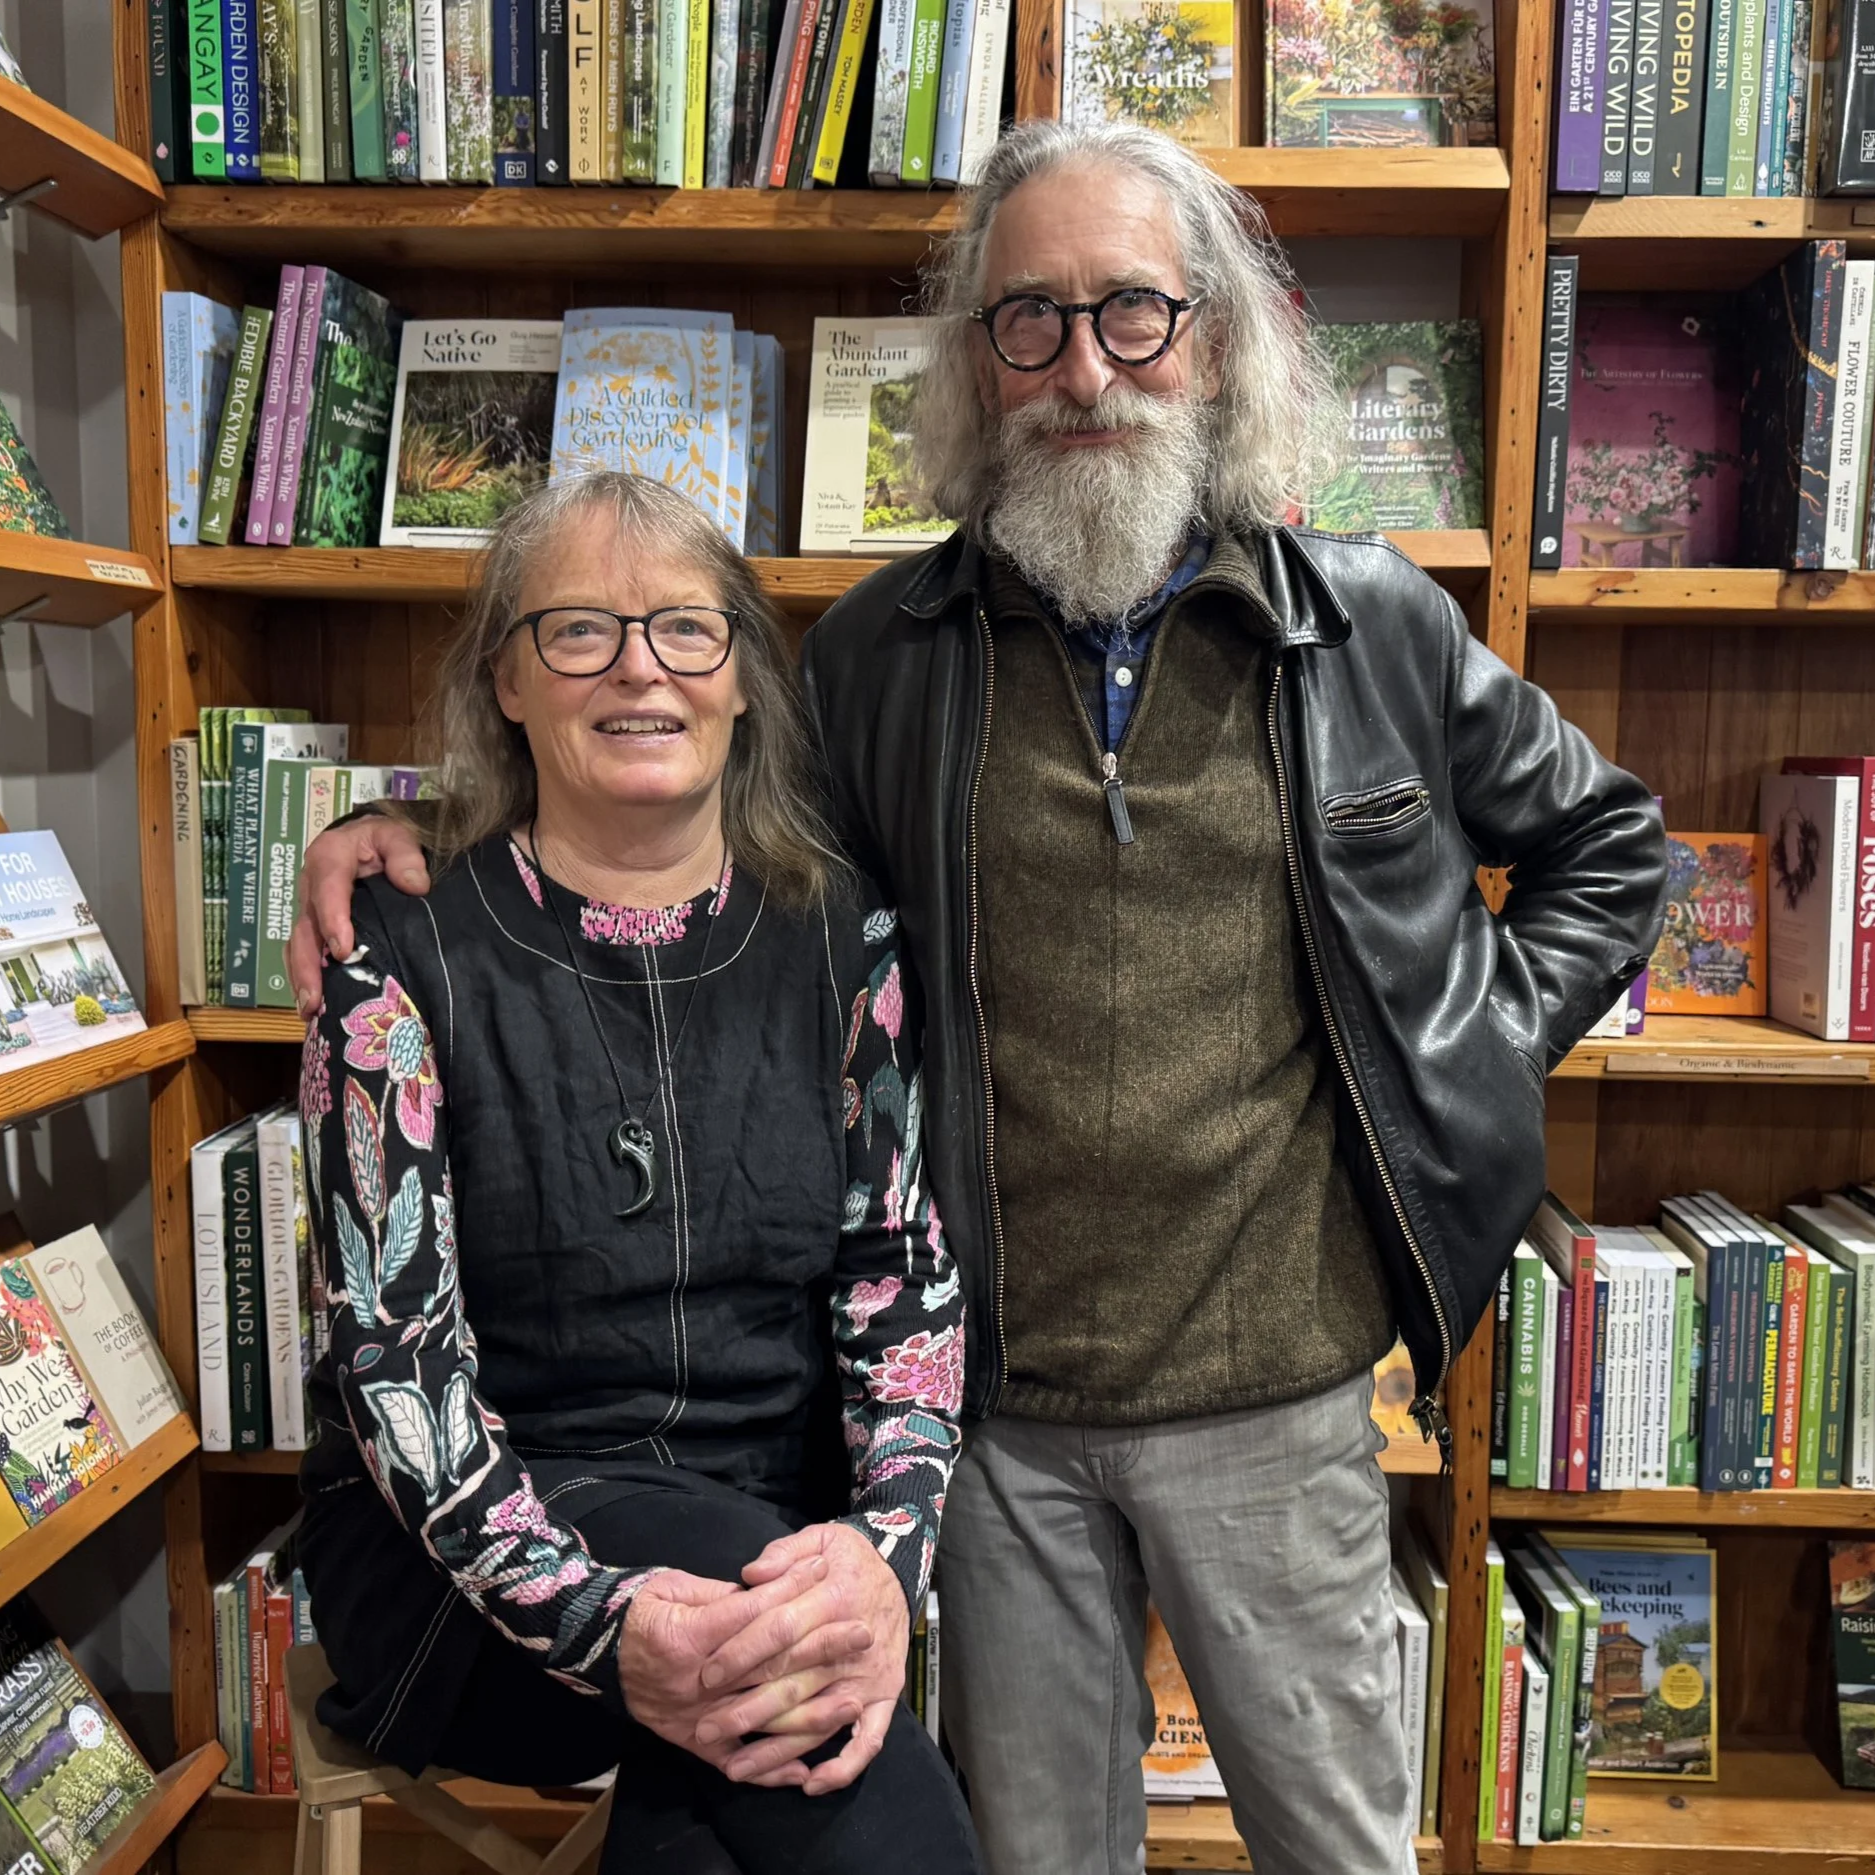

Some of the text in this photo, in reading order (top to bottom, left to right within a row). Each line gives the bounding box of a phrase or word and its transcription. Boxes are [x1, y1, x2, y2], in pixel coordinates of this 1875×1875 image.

[328, 1, 338, 57] SEASONS
[358, 26, 374, 82] GARDEN
[633, 12, 646, 81] Landscapes
[664, 12, 676, 69] Gardener
[814, 15, 831, 59] STONE
[913, 19, 927, 89] UNSWORTH
[925, 19, 939, 74] RICHARD
[510, 47, 520, 87] Gardener
[608, 38, 617, 132] OF MIEN RUYS
[833, 56, 853, 115] TOM MASSEY
[976, 32, 994, 136] LYNDA HALLINAN
[1091, 64, 1209, 89] Wreaths
[1569, 10, 1584, 112] EIN GARTEN FÜR
[1584, 15, 1597, 112] A CENTURY
[1715, 72, 1727, 90] IN
[230, 66, 250, 144] DESIGN
[1604, 83, 1628, 156] WILD
[1633, 83, 1655, 156] WILD
[1735, 52, 1755, 136] and Design
[1763, 71, 1773, 126] HOUSEPLANTS
[578, 106, 591, 145] WORK
[508, 163, 525, 176] DK
[1551, 269, 1572, 347] PRETTY
[237, 318, 260, 377] EDIBLE
[422, 346, 482, 364] Native
[424, 328, 497, 346] Let's Go
[826, 346, 909, 362] Abundant
[828, 330, 861, 346] The
[255, 279, 295, 502] The Natural Garden Xanthe White
[278, 279, 318, 502] The Natural Garden Xanthe White
[599, 385, 694, 409] A Guided
[826, 362, 887, 378] Garden
[1547, 351, 1568, 412] DIRTY
[219, 377, 250, 468] BACKYARD
[569, 407, 705, 431] Discovery of
[1347, 420, 1446, 442] Gardens
[1351, 399, 1440, 421] Literary
[1839, 340, 1860, 466] FLOWER COUTURE
[571, 426, 689, 453] Gardening
[1360, 452, 1451, 464] Imaginary Gardens
[1359, 463, 1444, 475] Writers and Poets
[172, 745, 190, 842] GARDENING
[232, 765, 246, 864] ENCYCLOPEDIA
[314, 801, 328, 829] VEG
[1, 851, 37, 875] FOR
[241, 767, 260, 925] WHAT PLANT WHERE
[1838, 798, 1853, 911] Modern Dried Flowers
[2, 876, 71, 906] HOUSES
[20, 907, 56, 920] Landscapes
[266, 842, 284, 940] GARDENING
[282, 843, 296, 941] DOWN-TO-EARTH
[234, 984, 248, 997] DK
[1679, 1058, 1798, 1070] Organic & Biodynamic
[233, 1166, 254, 1346] WONDERLANDS
[266, 1161, 292, 1364] GLORIOUS GARDENS
[197, 1212, 222, 1371] LOTUSLAND
[1836, 1287, 1846, 1305] The
[93, 1311, 138, 1345] THE BOOK
[113, 1322, 144, 1353] COFFEE
[1520, 1277, 1536, 1375] CANNABIS
[1576, 1286, 1590, 1400] Square Foot Gardening
[1593, 1305, 1605, 1392] CLIMATE CHANGE GARDEN
[1607, 1322, 1617, 1359] Curiosity
[1619, 1322, 1629, 1359] Curiosity
[1630, 1322, 1640, 1359] Curiosity
[1808, 1272, 1825, 1412] How Garden Produce
[1830, 1306, 1845, 1377] Self-Sufficiency
[1859, 1263, 1874, 1419] Biodynamic Farming Handbook
[26, 1356, 61, 1390] We
[1494, 1293, 1510, 1445] Buds Ed Rosenthal
[1641, 1314, 1654, 1465] Curiosity Finding Freedom
[1656, 1314, 1669, 1465] Curiosity Finding Freedom
[1677, 1347, 1686, 1384] Handbook
[1709, 1325, 1721, 1407] The Lean Micro Farm
[1762, 1328, 1779, 1415] PERMACULTURE
[1781, 1304, 1800, 1443] GARDEN TO SAVE THE WORLD
[0, 1380, 76, 1439] Garden
[1829, 1378, 1840, 1412] Garden
[33, 1444, 109, 1508] HANNAH MOLONEY
[1589, 1576, 1672, 1598] Bees and
[300, 1627, 313, 1642] TO
[929, 1627, 938, 1656] Grow
[16, 1677, 56, 1718] creative rural
[253, 1680, 266, 1729] Gardening
[1409, 1635, 1420, 1730] FOR THE LOVE OF SOIL
[13, 1698, 53, 1737] Kiwi women
[1500, 1660, 1514, 1772] RAISING CHICKENS
[1525, 1729, 1538, 1774] Chickens
[76, 1803, 108, 1838] HEATHER
